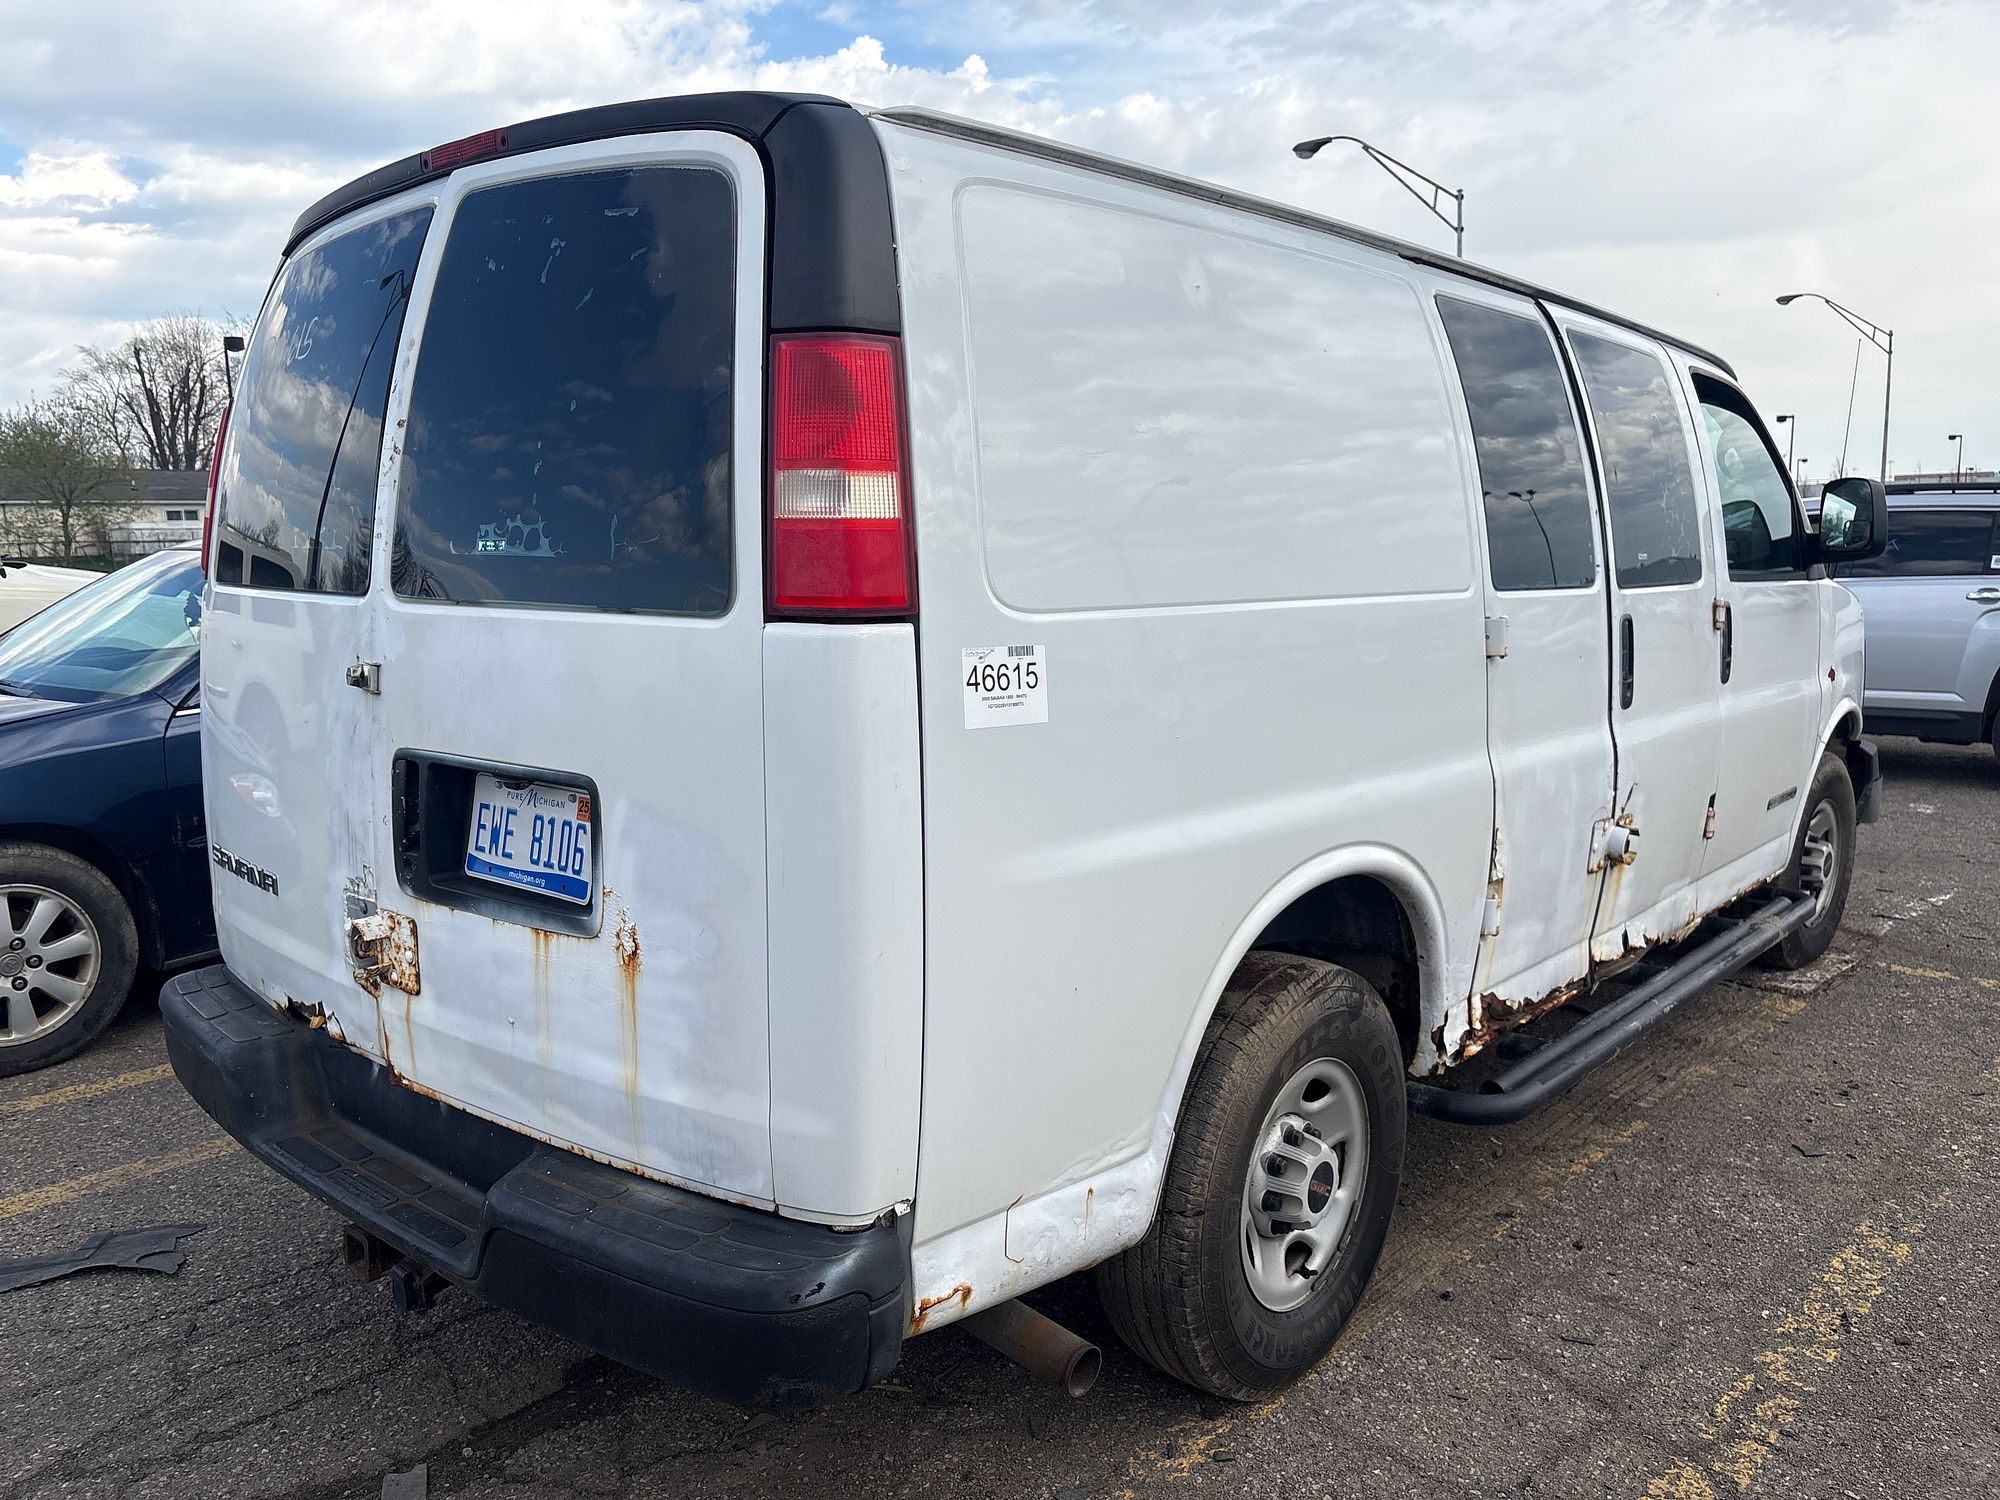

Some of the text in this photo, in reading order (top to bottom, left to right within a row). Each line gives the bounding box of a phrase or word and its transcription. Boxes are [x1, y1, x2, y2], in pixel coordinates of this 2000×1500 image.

[966, 662, 1038, 692] 46615
[506, 788, 566, 809] PURE MICHIGAN
[578, 799, 590, 814] 25
[474, 802, 588, 876] EWE 8106
[212, 842, 279, 896] SAVANA
[508, 870, 546, 886] michigan.org
[1279, 1018, 1400, 1122] Firestone
[1309, 1179, 1331, 1197] GMC
[1241, 1270, 1365, 1362] TRANSFORCE
